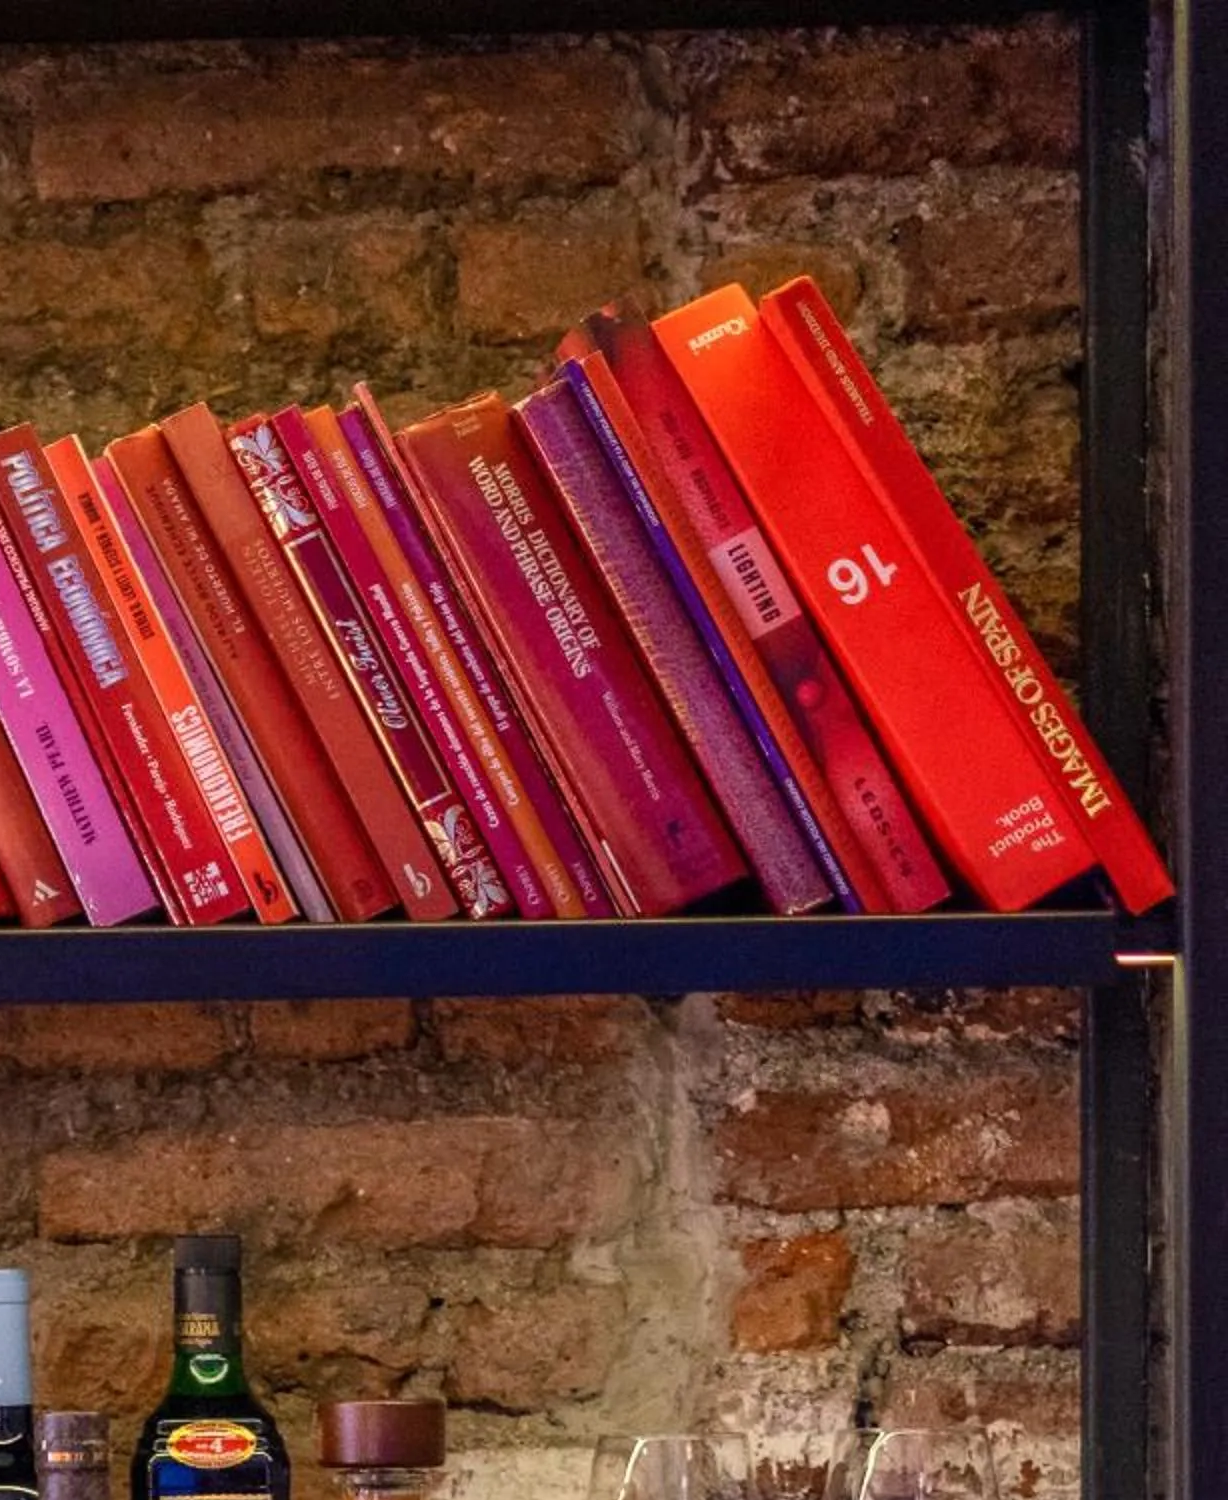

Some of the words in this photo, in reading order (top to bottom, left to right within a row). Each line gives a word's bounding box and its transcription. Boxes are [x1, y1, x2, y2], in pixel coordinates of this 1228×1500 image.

[160, 476, 191, 524] AMADA
[183, 523, 199, 542] MI
[192, 542, 210, 563] DE
[490, 459, 535, 526] MORRIS
[525, 527, 589, 628] DICTIONARY
[575, 623, 602, 654] OF
[0, 444, 73, 554] POLÍTICA
[46, 551, 130, 690] ECONÓMICA
[202, 561, 237, 615] HUERTO
[466, 453, 505, 509] WORD
[492, 503, 522, 543] AND
[509, 536, 556, 608] PHRASE
[542, 603, 594, 680] ORIGINS
[723, 541, 785, 624] LIGHTING
[827, 544, 898, 604] 16
[229, 615, 247, 635] EL
[290, 614, 313, 646] LOS
[328, 611, 385, 679] Twist
[953, 579, 1026, 670] SPAIN
[13, 675, 34, 700] LA
[359, 670, 413, 735] Oliver
[1002, 658, 1049, 710] OF
[32, 720, 66, 772] PEARL
[168, 702, 254, 844] FREAKONOMICS
[1024, 698, 1114, 818] IMAGES
[55, 770, 97, 846] MATTHEW
[988, 812, 1054, 858] Product
[1031, 828, 1066, 852] The
